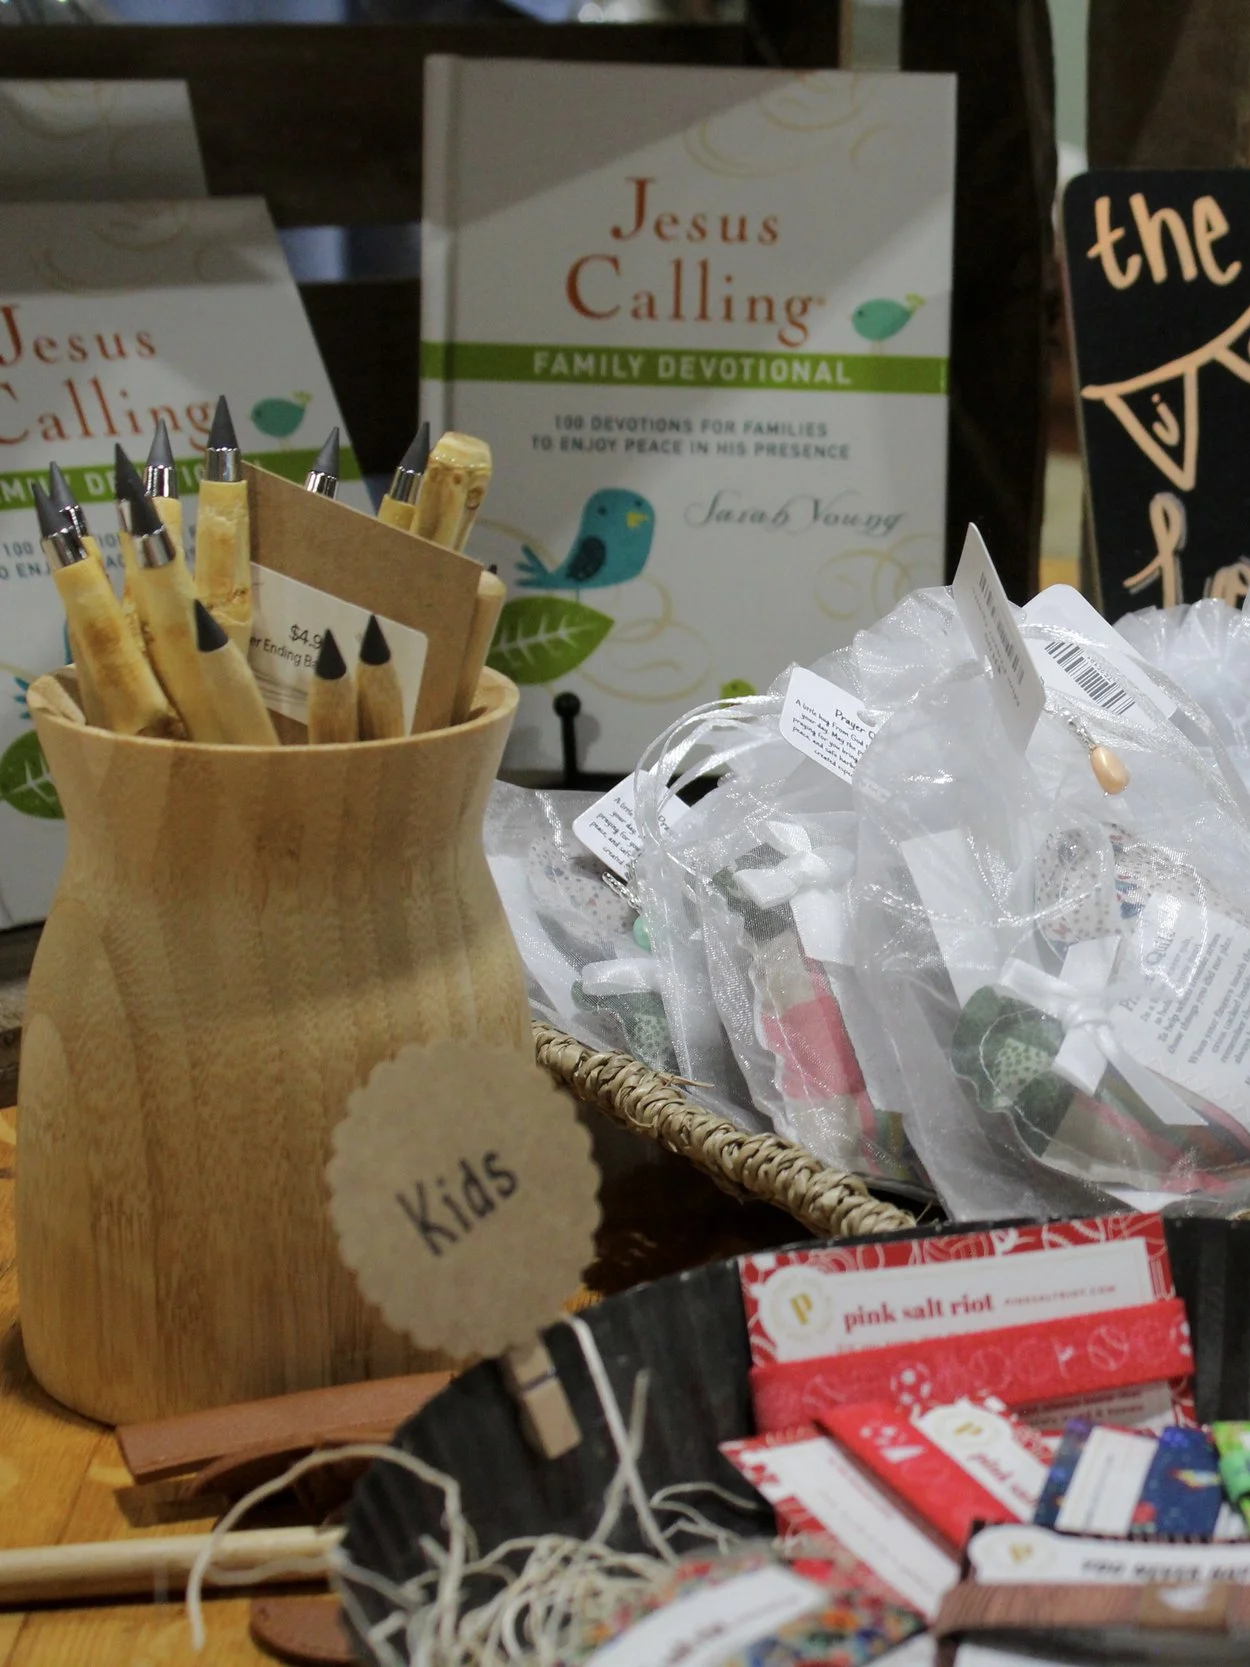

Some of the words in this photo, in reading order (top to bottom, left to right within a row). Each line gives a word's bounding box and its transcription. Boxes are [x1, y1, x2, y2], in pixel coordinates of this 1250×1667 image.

[610, 176, 780, 246] Jesus
[1087, 193, 1241, 289] the
[565, 254, 814, 347] Calling
[0, 305, 156, 365] Jesus
[533, 350, 644, 381] FAMILY
[657, 353, 854, 386] DEVOTIONAL
[554, 414, 585, 430] 100
[590, 415, 693, 434] DEVOTIONS
[700, 418, 735, 435] FOR
[742, 419, 828, 437] FAMILIES
[530, 434, 553, 450] TO
[559, 435, 616, 452] ENJOY
[624, 437, 682, 456] PEACE
[690, 441, 708, 456] IN
[716, 441, 746, 457] HIS
[753, 442, 850, 460] PRESENCE
[684, 489, 792, 534] Sarah
[805, 491, 908, 535] Young
[4, 540, 34, 556] 100
[263, 638, 302, 667] Ending
[290, 624, 323, 650] $4.9
[793, 717, 816, 737] praying
[835, 708, 865, 733] Prayer
[396, 1152, 520, 1258] Kids
[843, 1302, 896, 1334] pink
[902, 1297, 945, 1320] salt
[951, 1293, 994, 1317] riot
